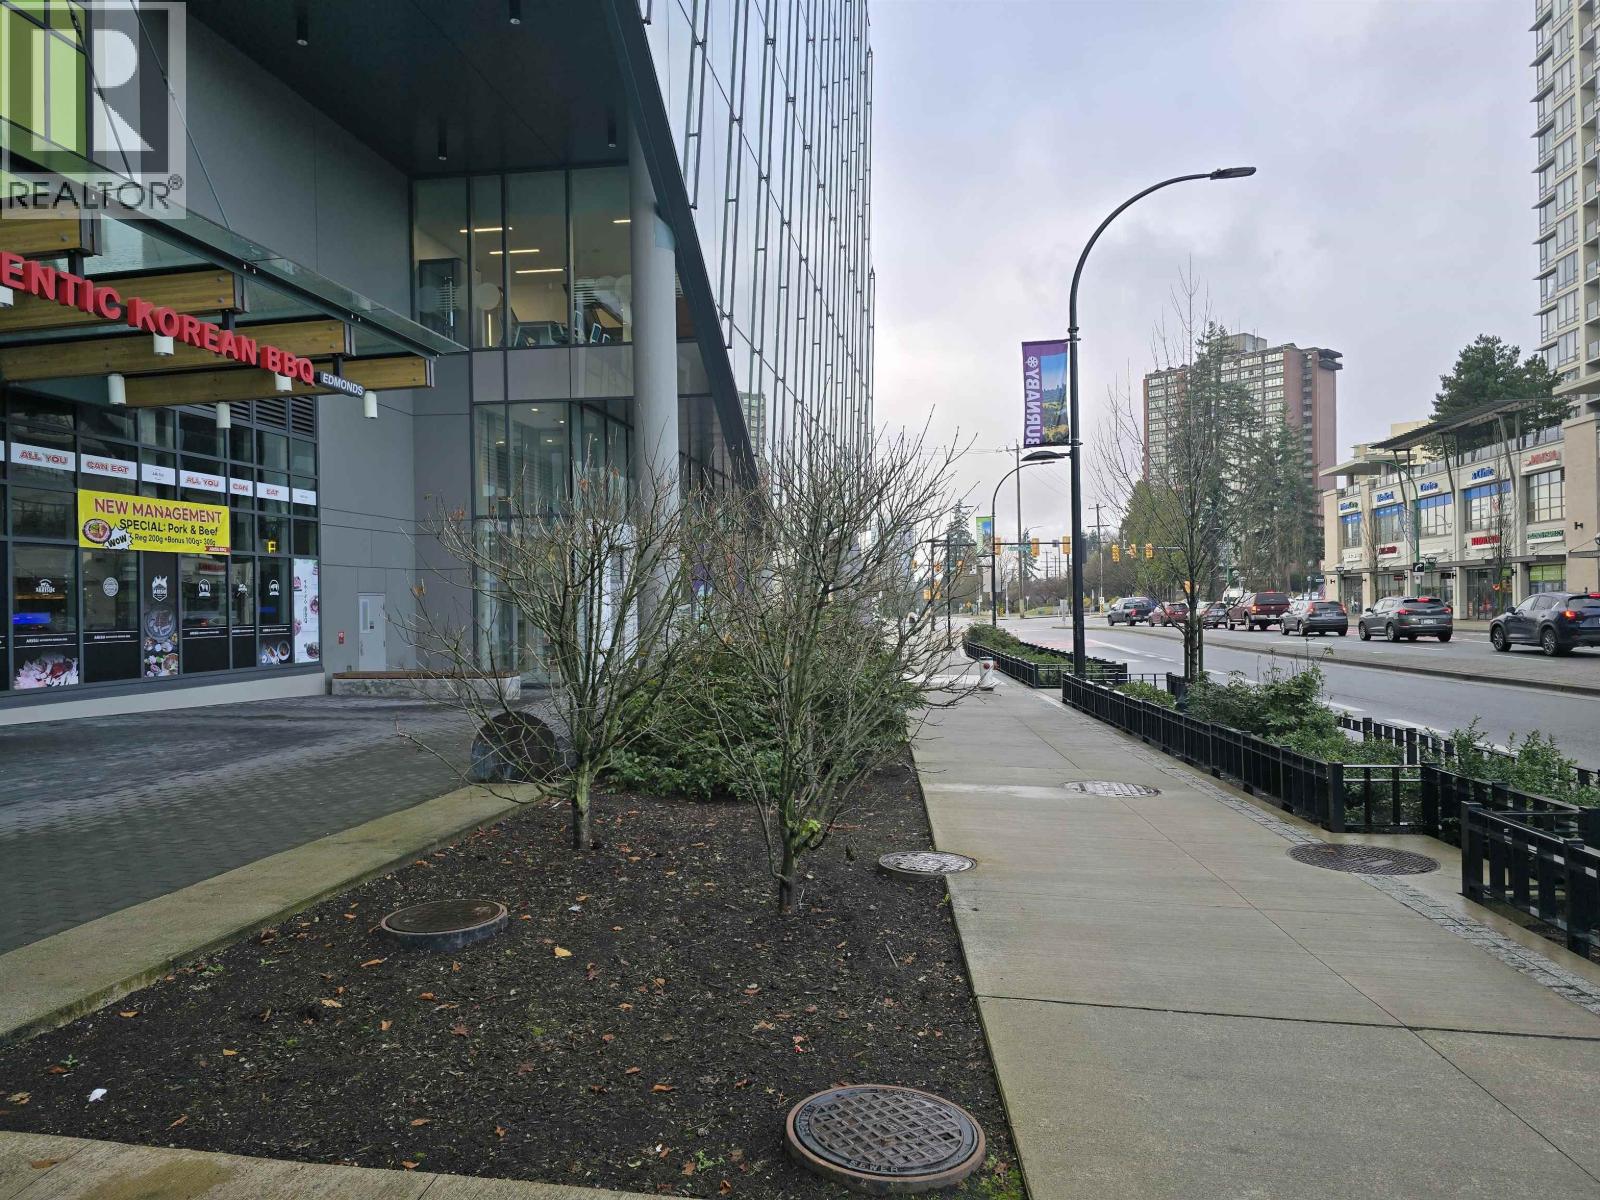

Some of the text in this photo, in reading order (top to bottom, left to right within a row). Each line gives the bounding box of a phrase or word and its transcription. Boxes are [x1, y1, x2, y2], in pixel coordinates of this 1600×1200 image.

[0, 251, 316, 387] ENTIC KOREAN BBQ
[322, 373, 364, 396] EDMONDS
[19, 450, 130, 474] ALL YOU CAN EAT
[185, 475, 279, 497] ALL YOU CAN EAT
[94, 498, 222, 524] NEW MANAGEMENT
[119, 518, 219, 536] SPECIAL: Pork & Beef
[134, 534, 148, 544] Reg
[148, 534, 163, 544] 200g
[848, 1159, 899, 1173] SEWER
